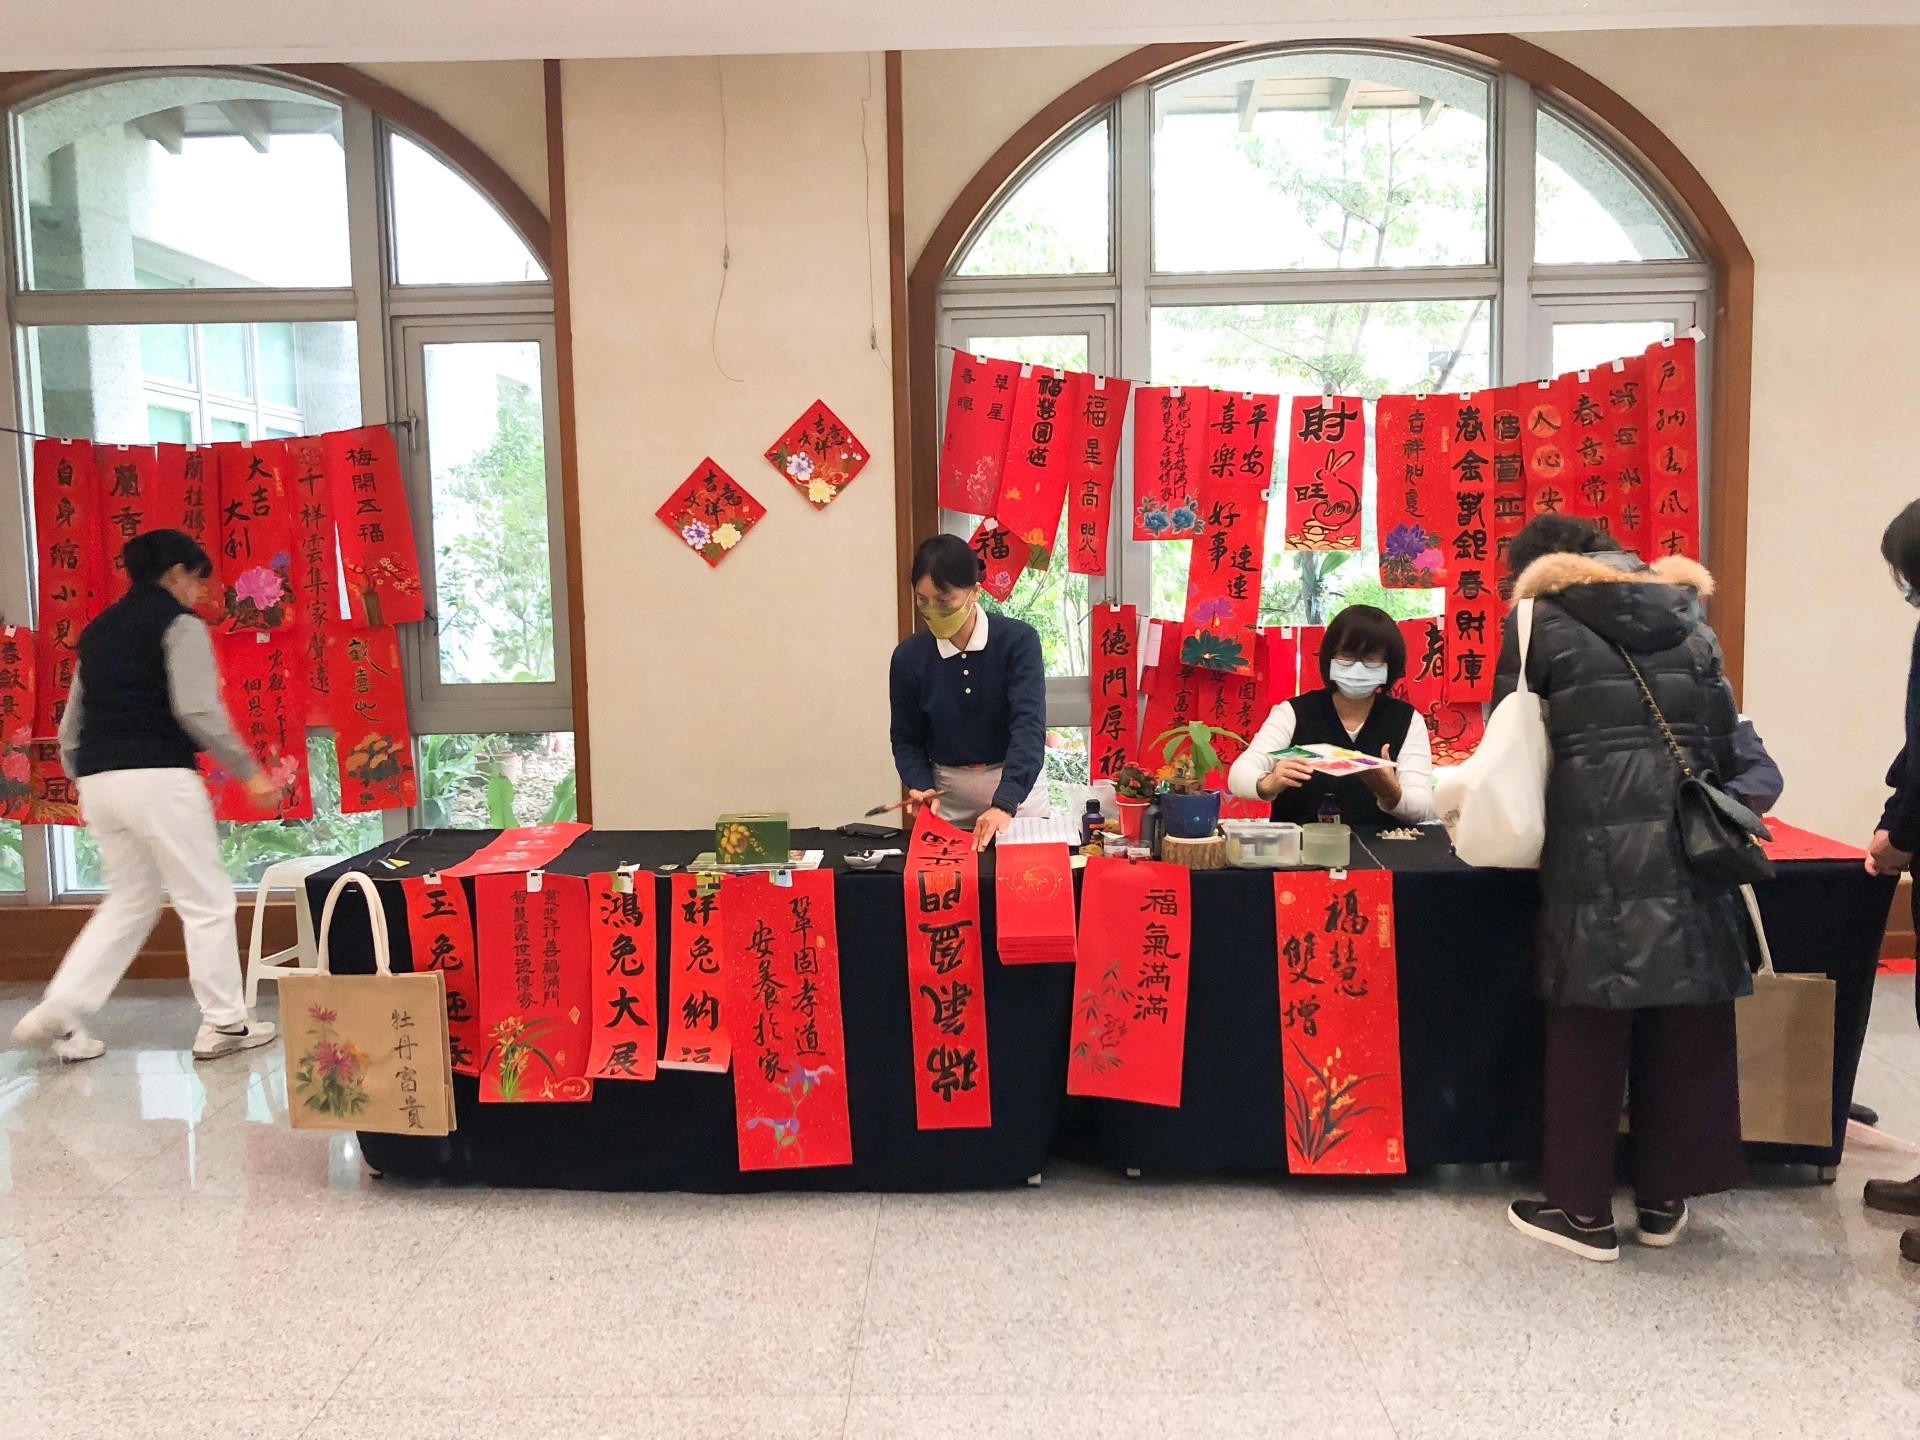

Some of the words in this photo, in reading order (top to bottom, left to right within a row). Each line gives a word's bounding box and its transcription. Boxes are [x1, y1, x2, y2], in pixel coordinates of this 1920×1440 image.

[1209, 397, 1242, 479] 喜樂
[1239, 401, 1272, 479] 平安
[1297, 402, 1357, 443] 財
[1530, 409, 1565, 514] 人心安
[246, 455, 274, 517] 大吉
[345, 448, 385, 543] 梅開五福
[223, 499, 252, 560] 大利
[975, 530, 1011, 562] 福
[1208, 501, 1240, 575] 好事
[598, 889, 651, 1077] 鴻兔大展
[1324, 888, 1370, 999] 福慧
[1281, 932, 1327, 1038] 雙增
[390, 1008, 425, 1130] 牡丹富貴
